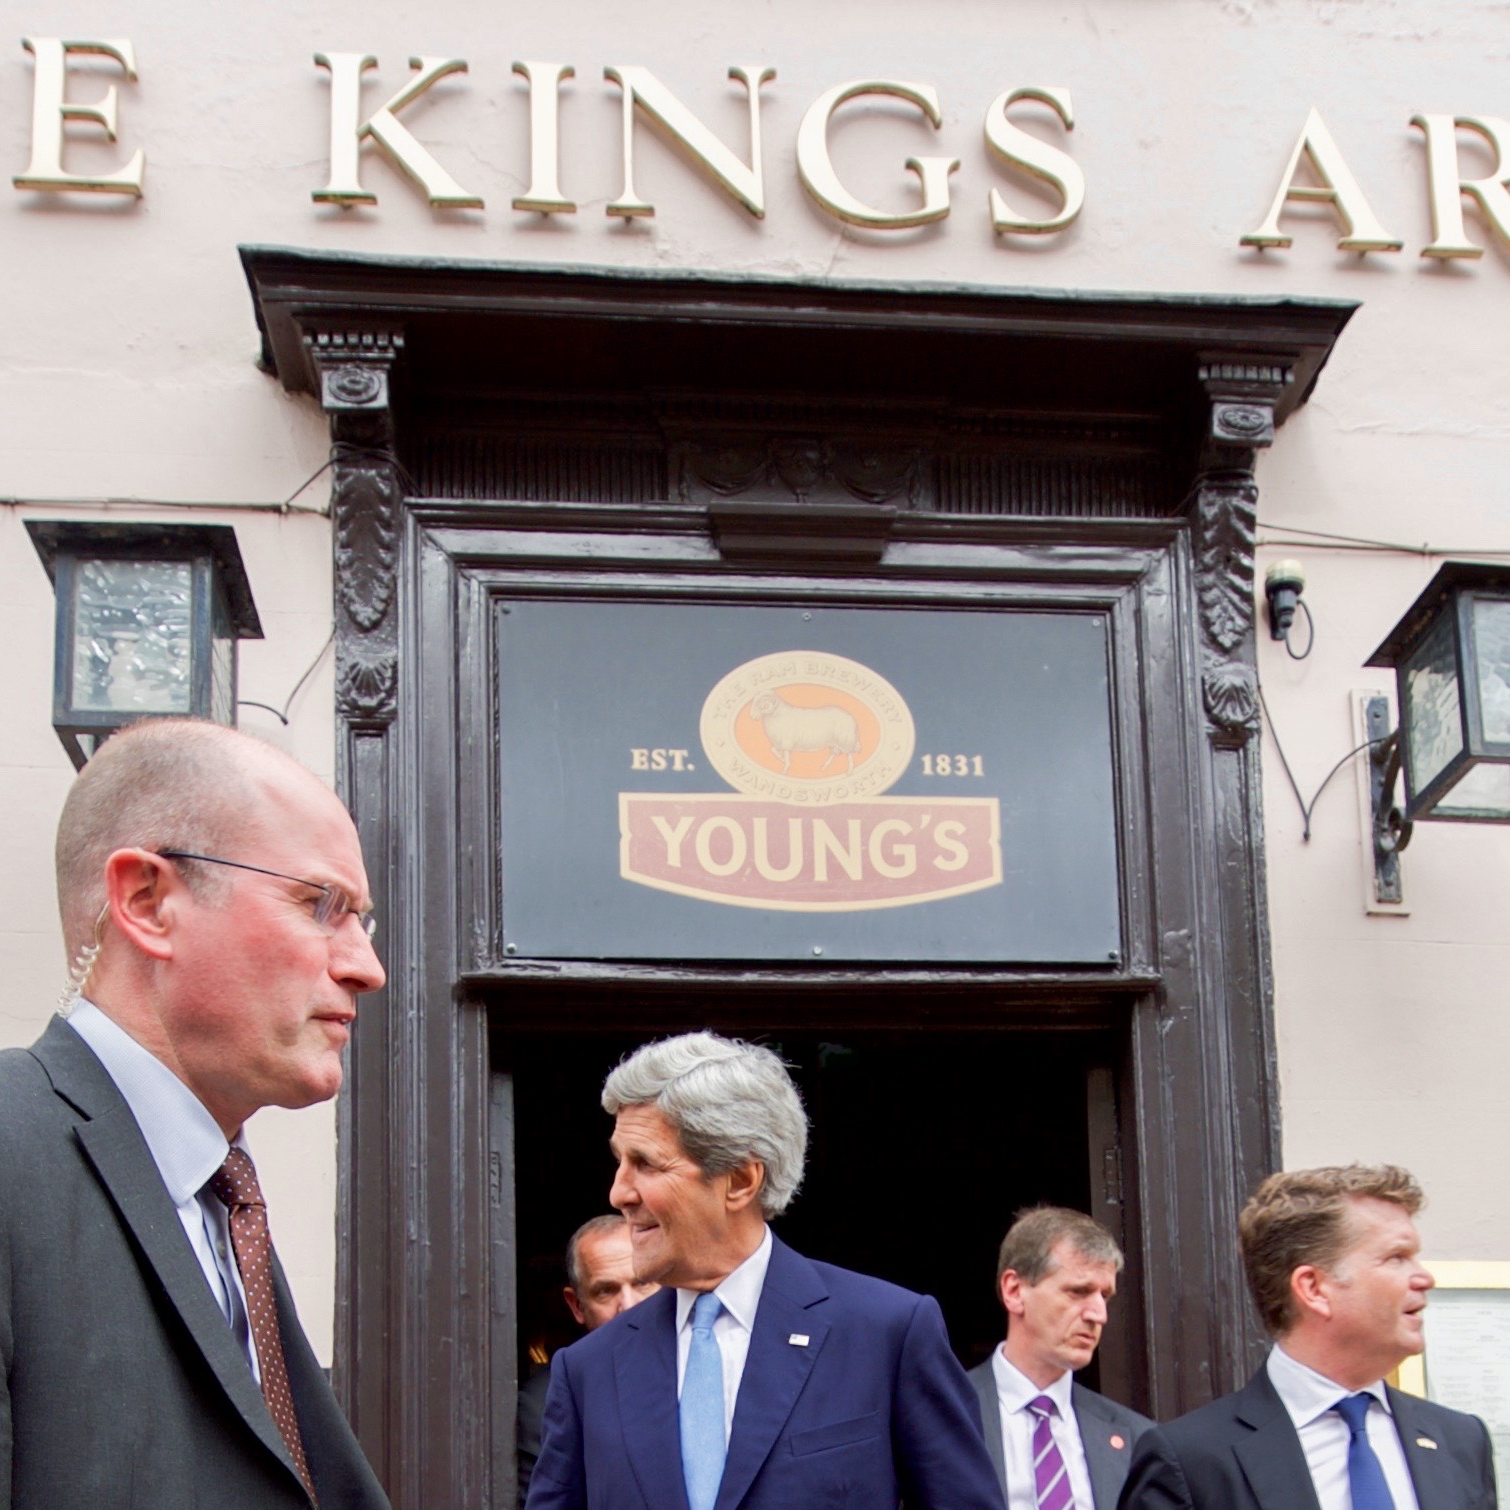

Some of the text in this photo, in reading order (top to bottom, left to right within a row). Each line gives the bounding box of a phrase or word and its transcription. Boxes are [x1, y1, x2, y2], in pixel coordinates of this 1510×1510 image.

[311, 51, 1086, 235] KINGS
[713, 660, 902, 725] THE RAM BREWERY
[631, 748, 984, 777] EST. 1831
[728, 757, 892, 802] WANDSWORTH
[651, 814, 969, 882] YOUNG'S
